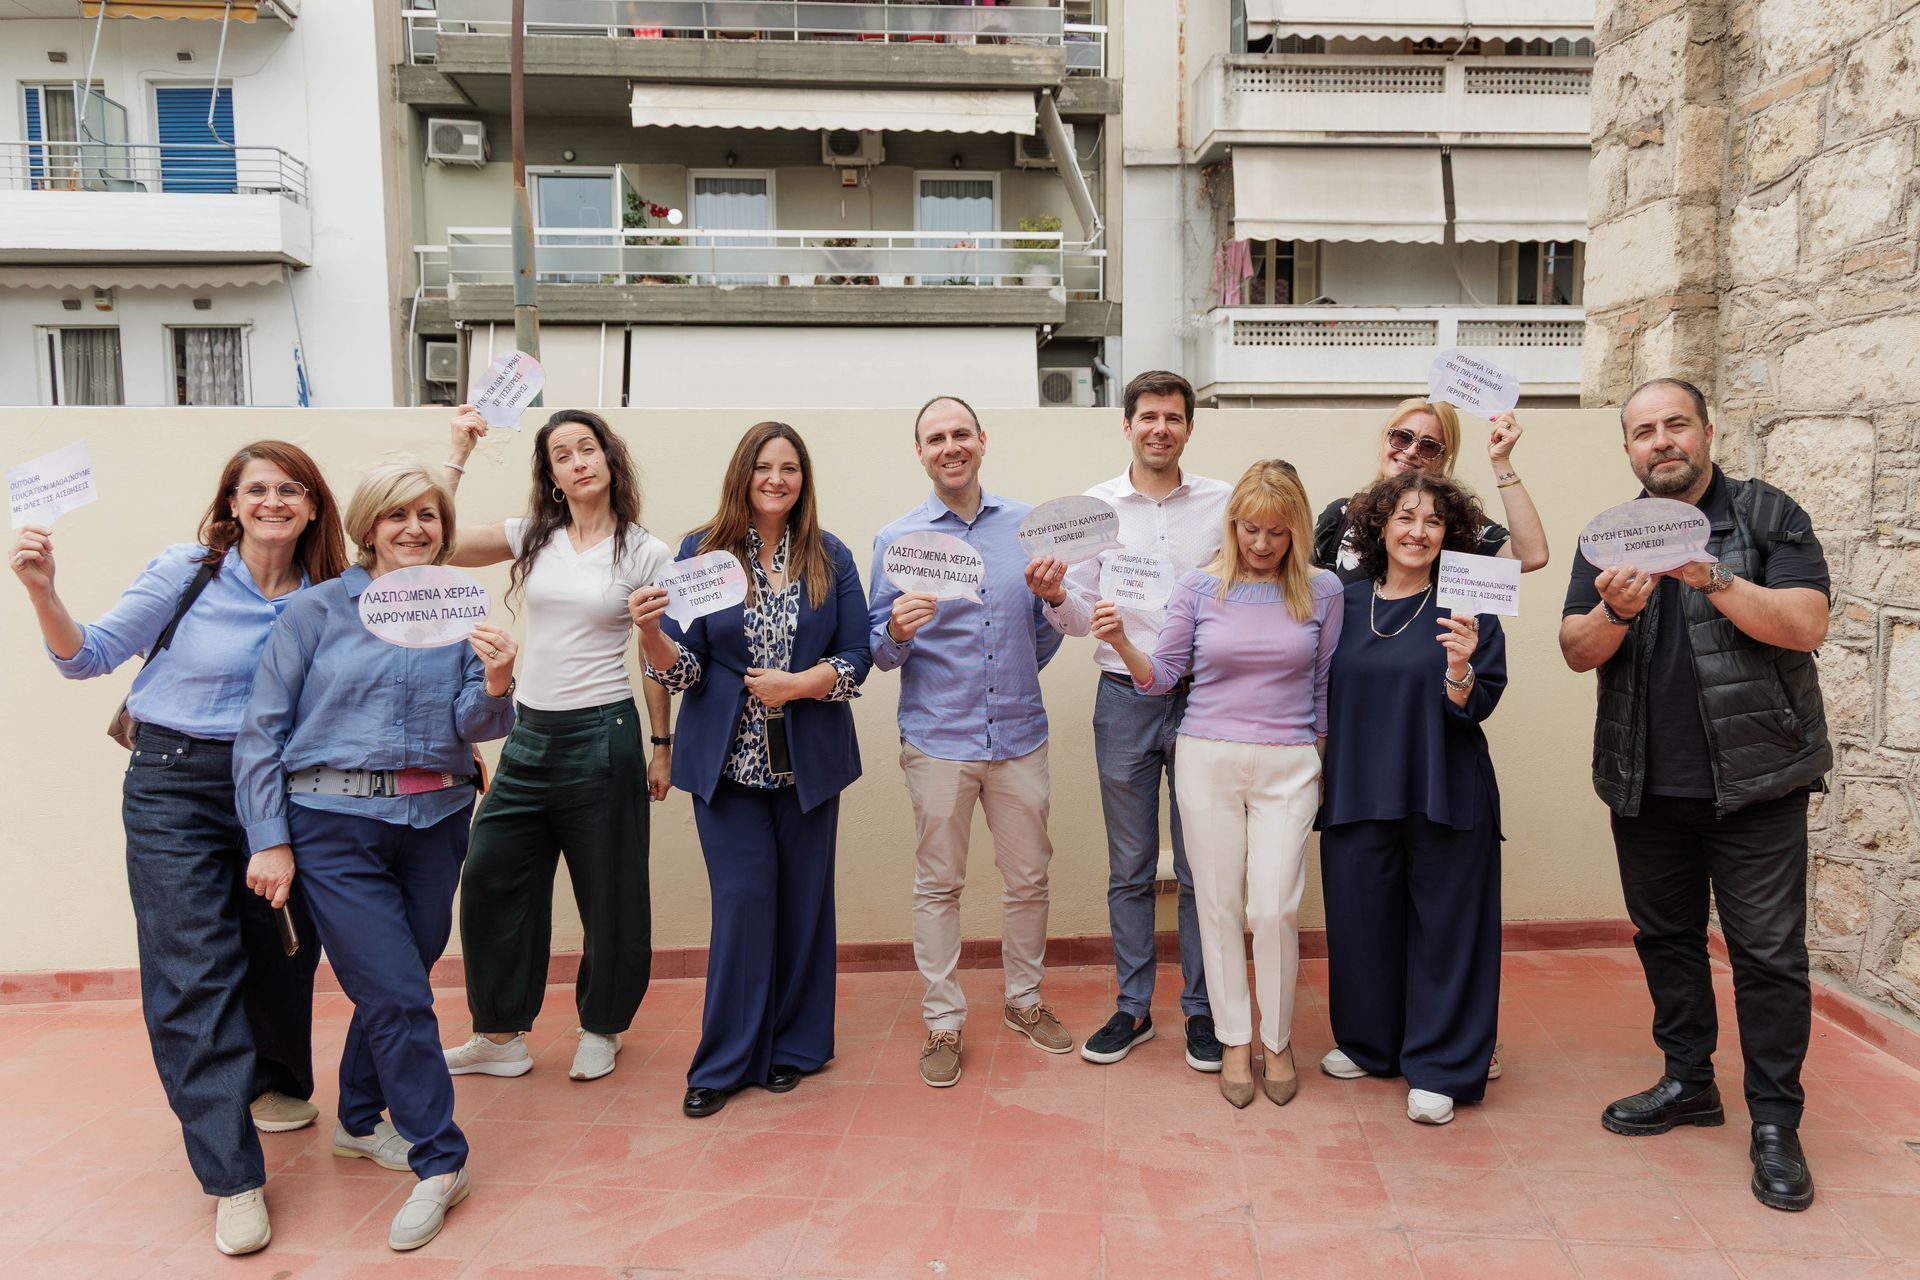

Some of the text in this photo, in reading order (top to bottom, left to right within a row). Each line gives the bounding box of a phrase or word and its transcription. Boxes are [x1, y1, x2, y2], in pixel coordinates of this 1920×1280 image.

[1456, 354, 1483, 371] ΥΠΑΙΘΡΙΑ
[478, 386, 496, 406] ΓΝΩΣΗ
[494, 375, 505, 388] ΔΕΝ
[502, 354, 521, 376] ΧΩΡΑΕΙ
[1446, 362, 1460, 372] ΕΚΕΙ
[1460, 368, 1473, 378] ΠΟΥ
[1479, 377, 1502, 391] ΜΑΘΗΣΗ
[492, 372, 523, 407] ΣΕ ΤΕΣΣΕΡΕΙΣ
[1457, 379, 1481, 394] ΓΙΝΕΤΑΙ
[10, 475, 40, 490] OUTDOOR
[24, 499, 40, 510] ΟΛΕΣ
[43, 495, 53, 504] ΤΙΣ
[55, 481, 89, 499] ΑΙΣΘΗΣΕΙΣ
[1027, 526, 1046, 537] ΦΥΣΗ
[1048, 522, 1068, 532] ΕΙΝΑΙ
[1079, 512, 1114, 526] ΚΑΛΥΤΕΡΟ
[1591, 531, 1616, 542] ΦΥΣΗ
[1617, 528, 1642, 538] ΕΙΝΑΙ
[1645, 526, 1656, 534] ΤΟ
[1658, 519, 1704, 532] ΚΑΛΥΤΕΡΟ
[1054, 531, 1084, 543] ΣΧΟΛΕΙΟ!
[1625, 539, 1664, 551] ΣΧΟΛΕΙΟ!
[888, 546, 946, 562] ΛΑΣΠΩΜΕΝΑ
[665, 574, 691, 586] ΓΝΩΣΗ
[692, 569, 706, 579] ΔΕΝ
[708, 561, 735, 574] ΧΩΡΑΕΙ
[887, 563, 978, 584] ΧΑΡΟΥΜΕΝΑ ΠΑΙΔΙΑ
[1441, 565, 1469, 574] OUTDOOR
[678, 577, 725, 596] ΣΕ ΤΕΣΣΕΡΕΙΣ
[364, 588, 441, 604] ΛΑΣΠΩΜΕΝΑ
[689, 591, 722, 606] ΤΟΙΧΟΥΣ!
[1479, 592, 1512, 601] ΑΙΣΘΗΣΕΙΣ
[367, 606, 486, 624] ΧΑΡΟΥΜΕΝΑ ΠΑΙΔΙΑ
